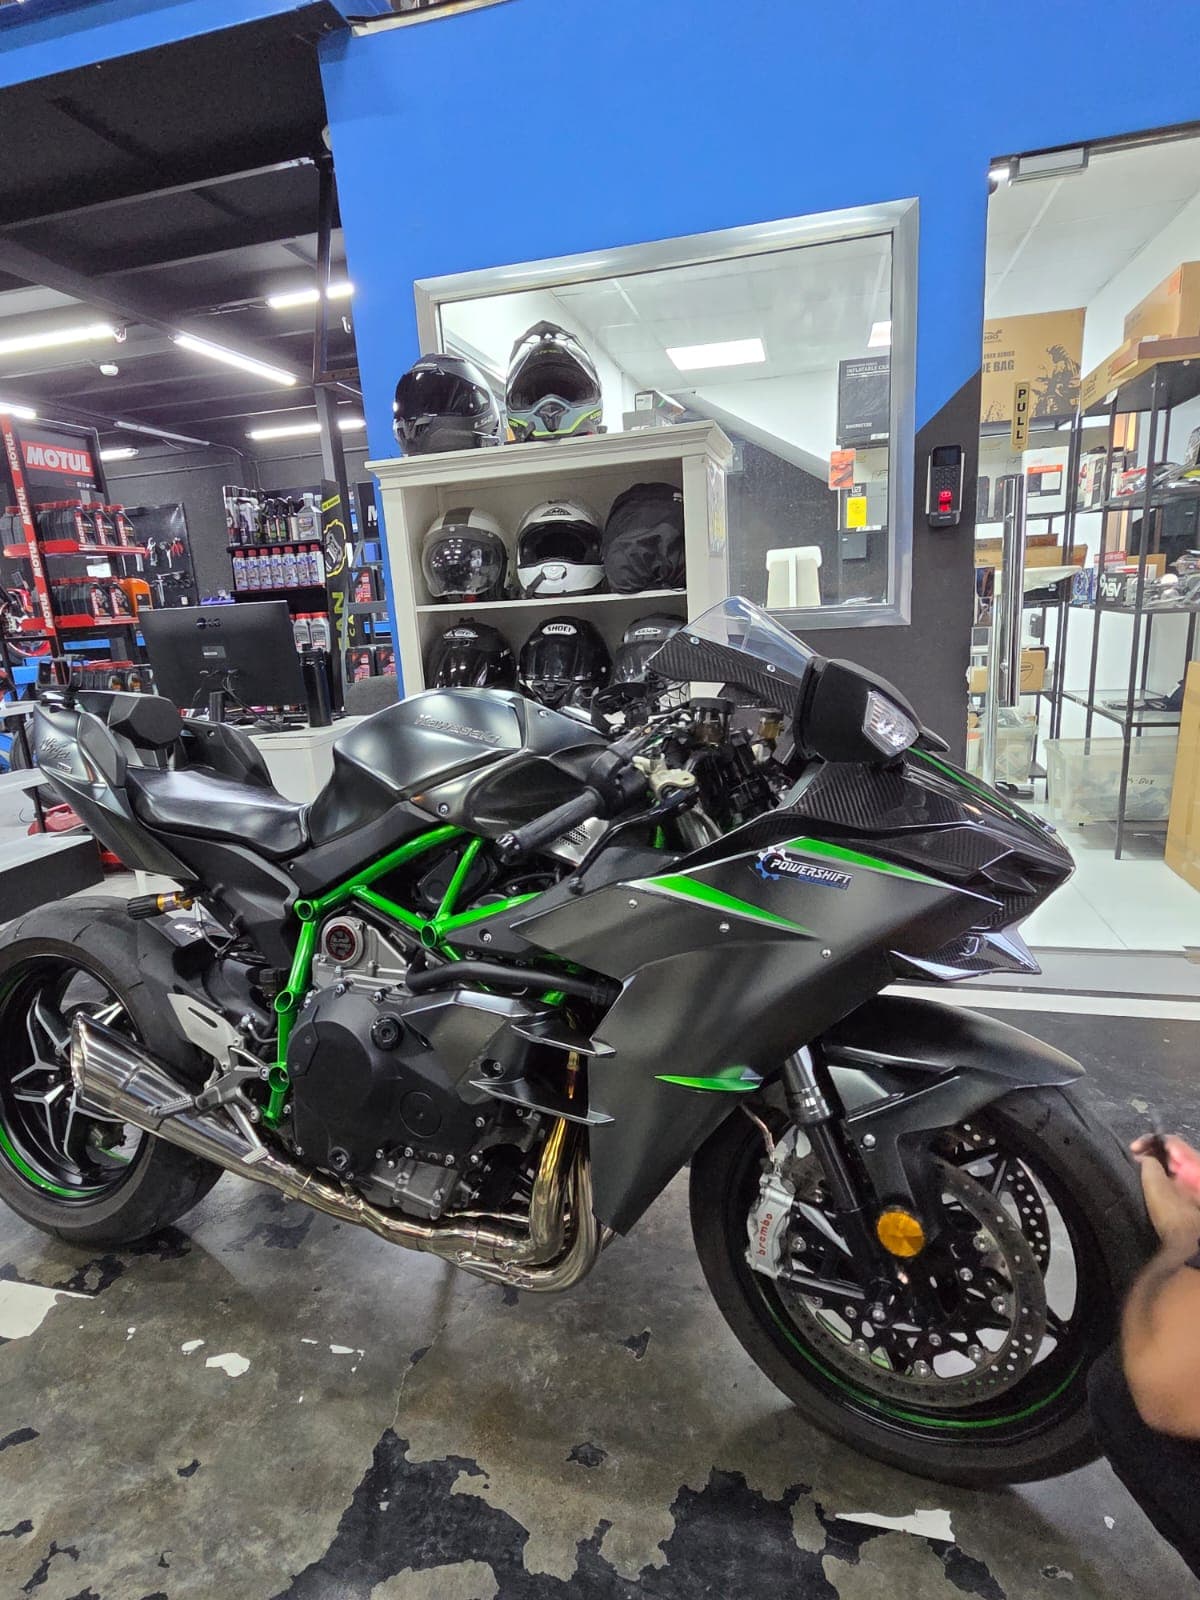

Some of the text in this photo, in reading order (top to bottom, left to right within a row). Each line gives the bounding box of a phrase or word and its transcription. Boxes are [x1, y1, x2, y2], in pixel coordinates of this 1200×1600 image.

[993, 360, 1015, 373] BAG
[1016, 388, 1027, 440] PULL
[4, 432, 20, 471] MOTUL
[26, 446, 91, 473] MOTUL
[16, 486, 32, 525] MOTUL
[28, 541, 43, 577] MOTUL
[40, 592, 54, 629] MOTUL
[547, 624, 572, 633] SHOEI
[770, 858, 853, 884] POWERSHIFT
[756, 1213, 773, 1256] brembo
